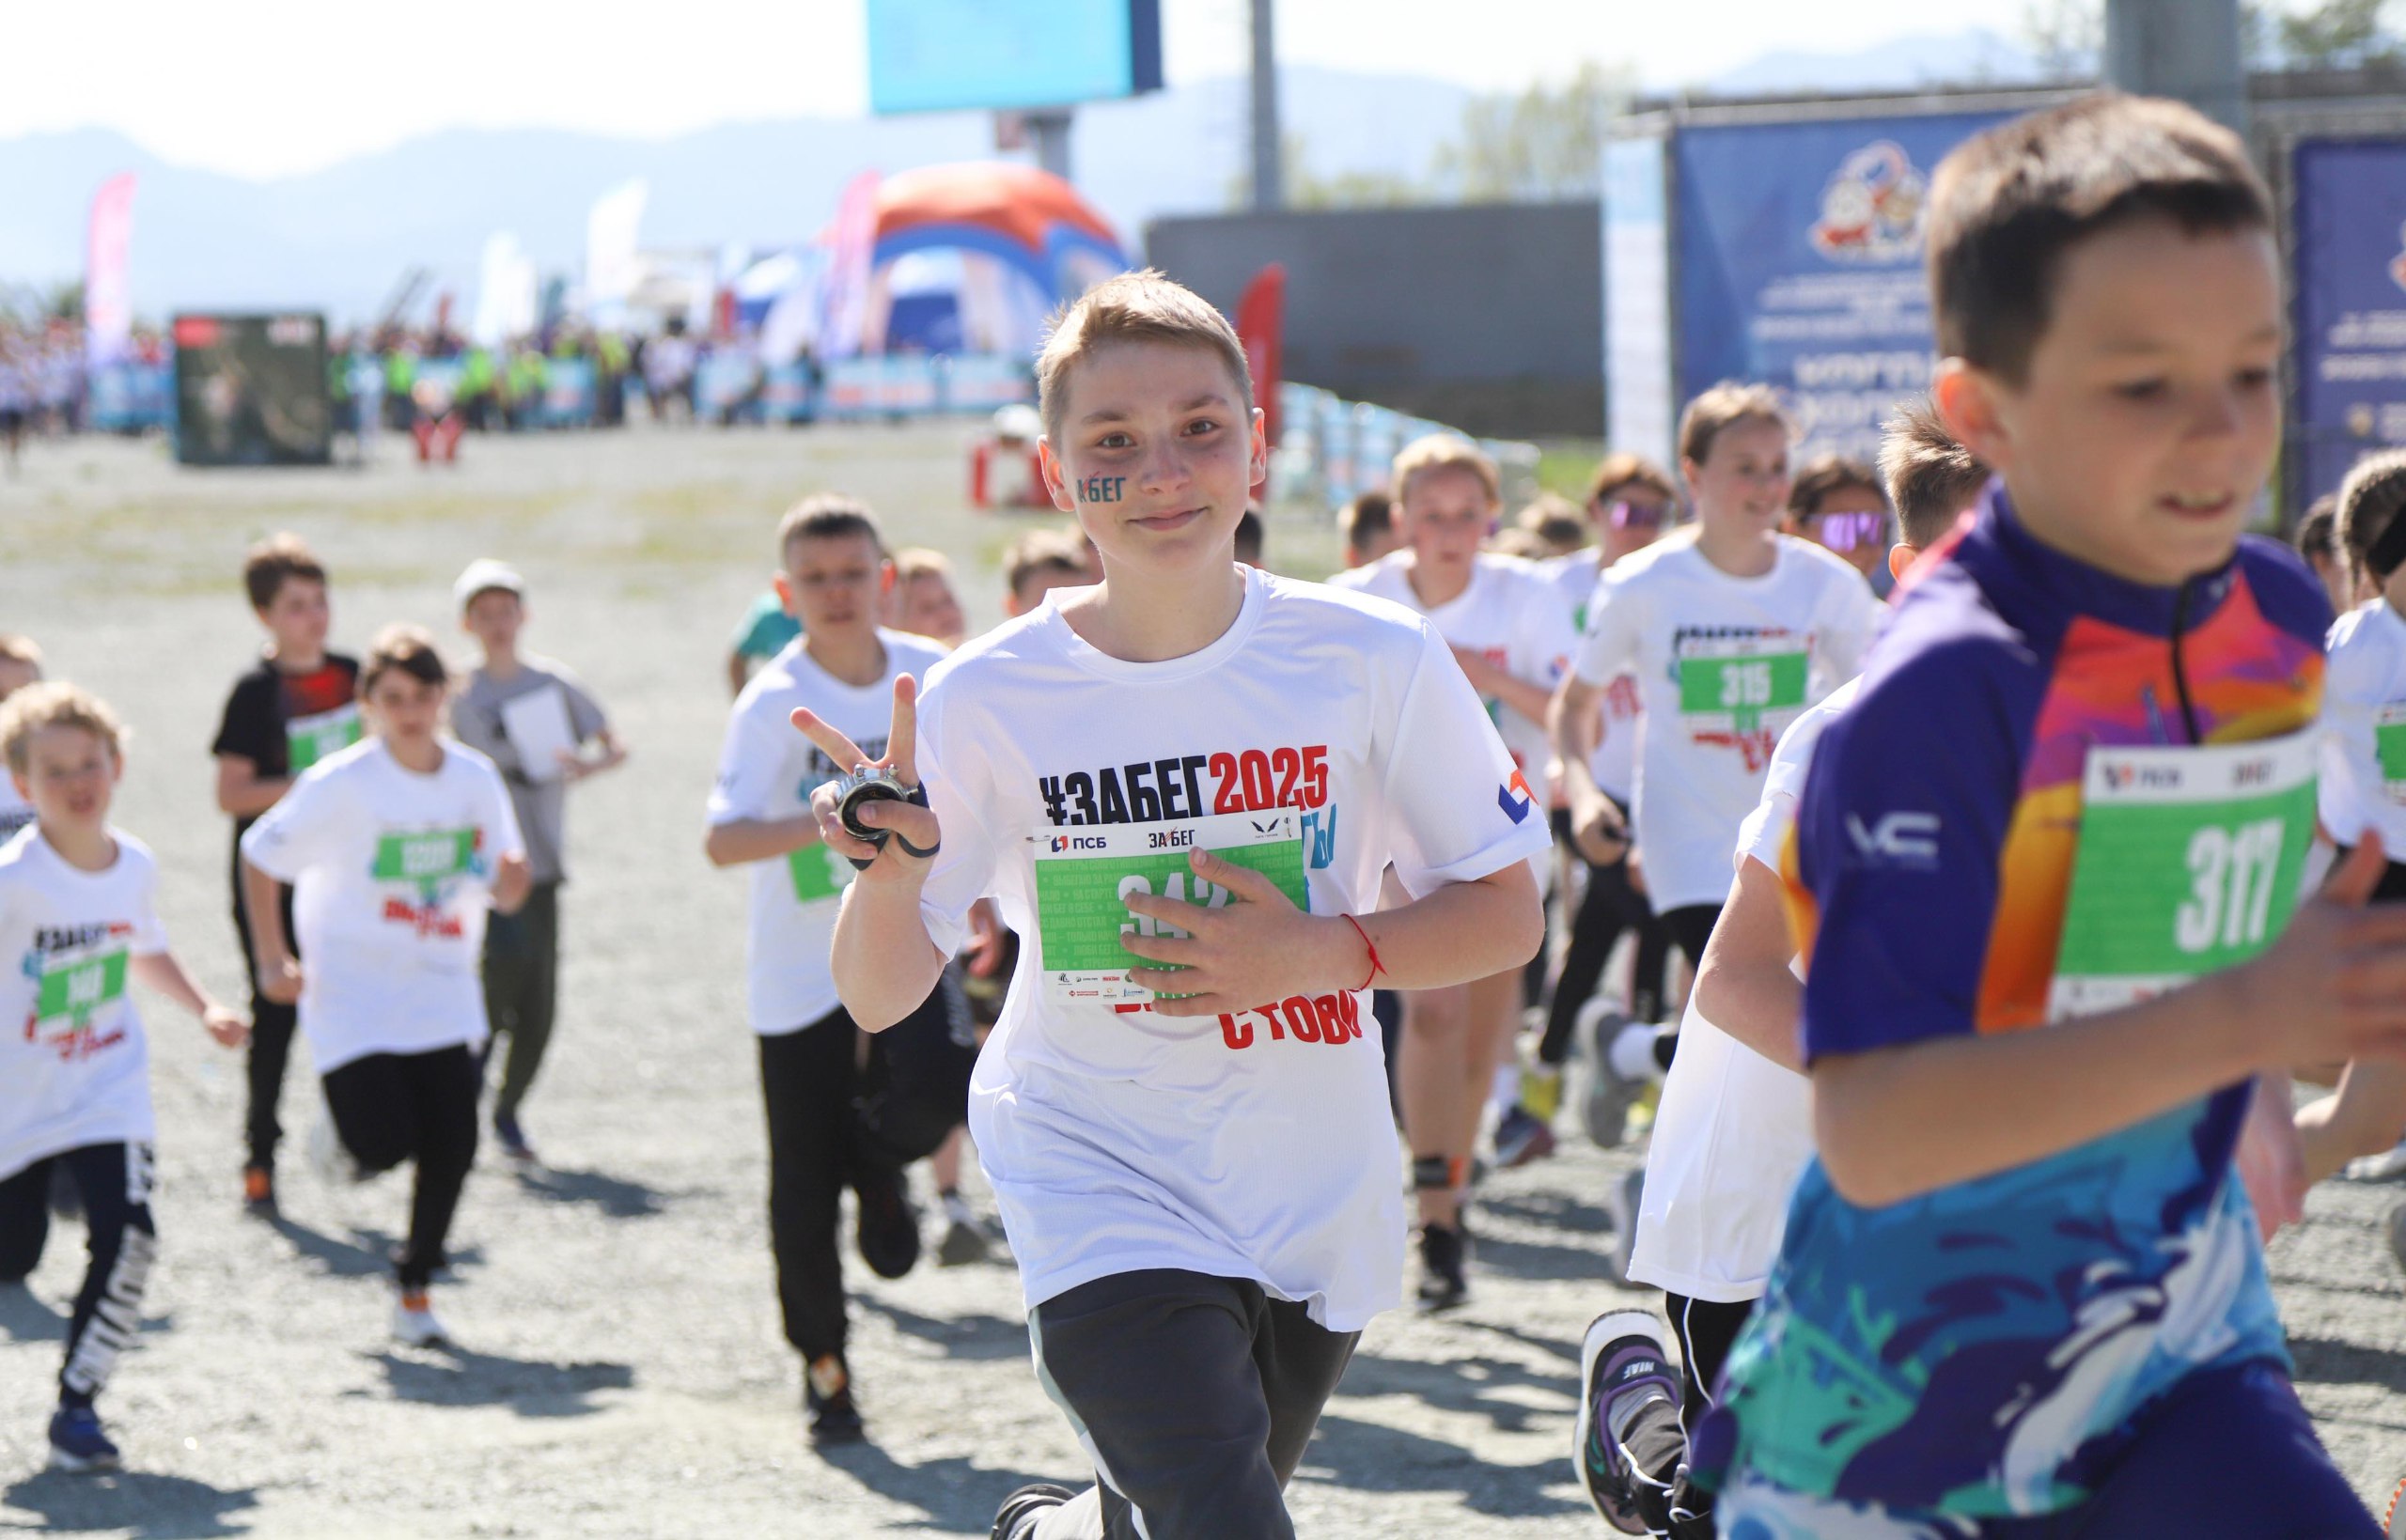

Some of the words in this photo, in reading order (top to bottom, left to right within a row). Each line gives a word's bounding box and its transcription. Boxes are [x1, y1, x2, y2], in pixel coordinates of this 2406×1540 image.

[1076, 476, 1127, 503] БЕГ
[1721, 661, 1771, 708] 315
[1039, 744, 1329, 826] #ЗАБЕГ2025
[1072, 836, 1107, 849] ПСБ
[1148, 829, 1195, 848] ЗАБЕГ
[2174, 817, 2287, 954] 317
